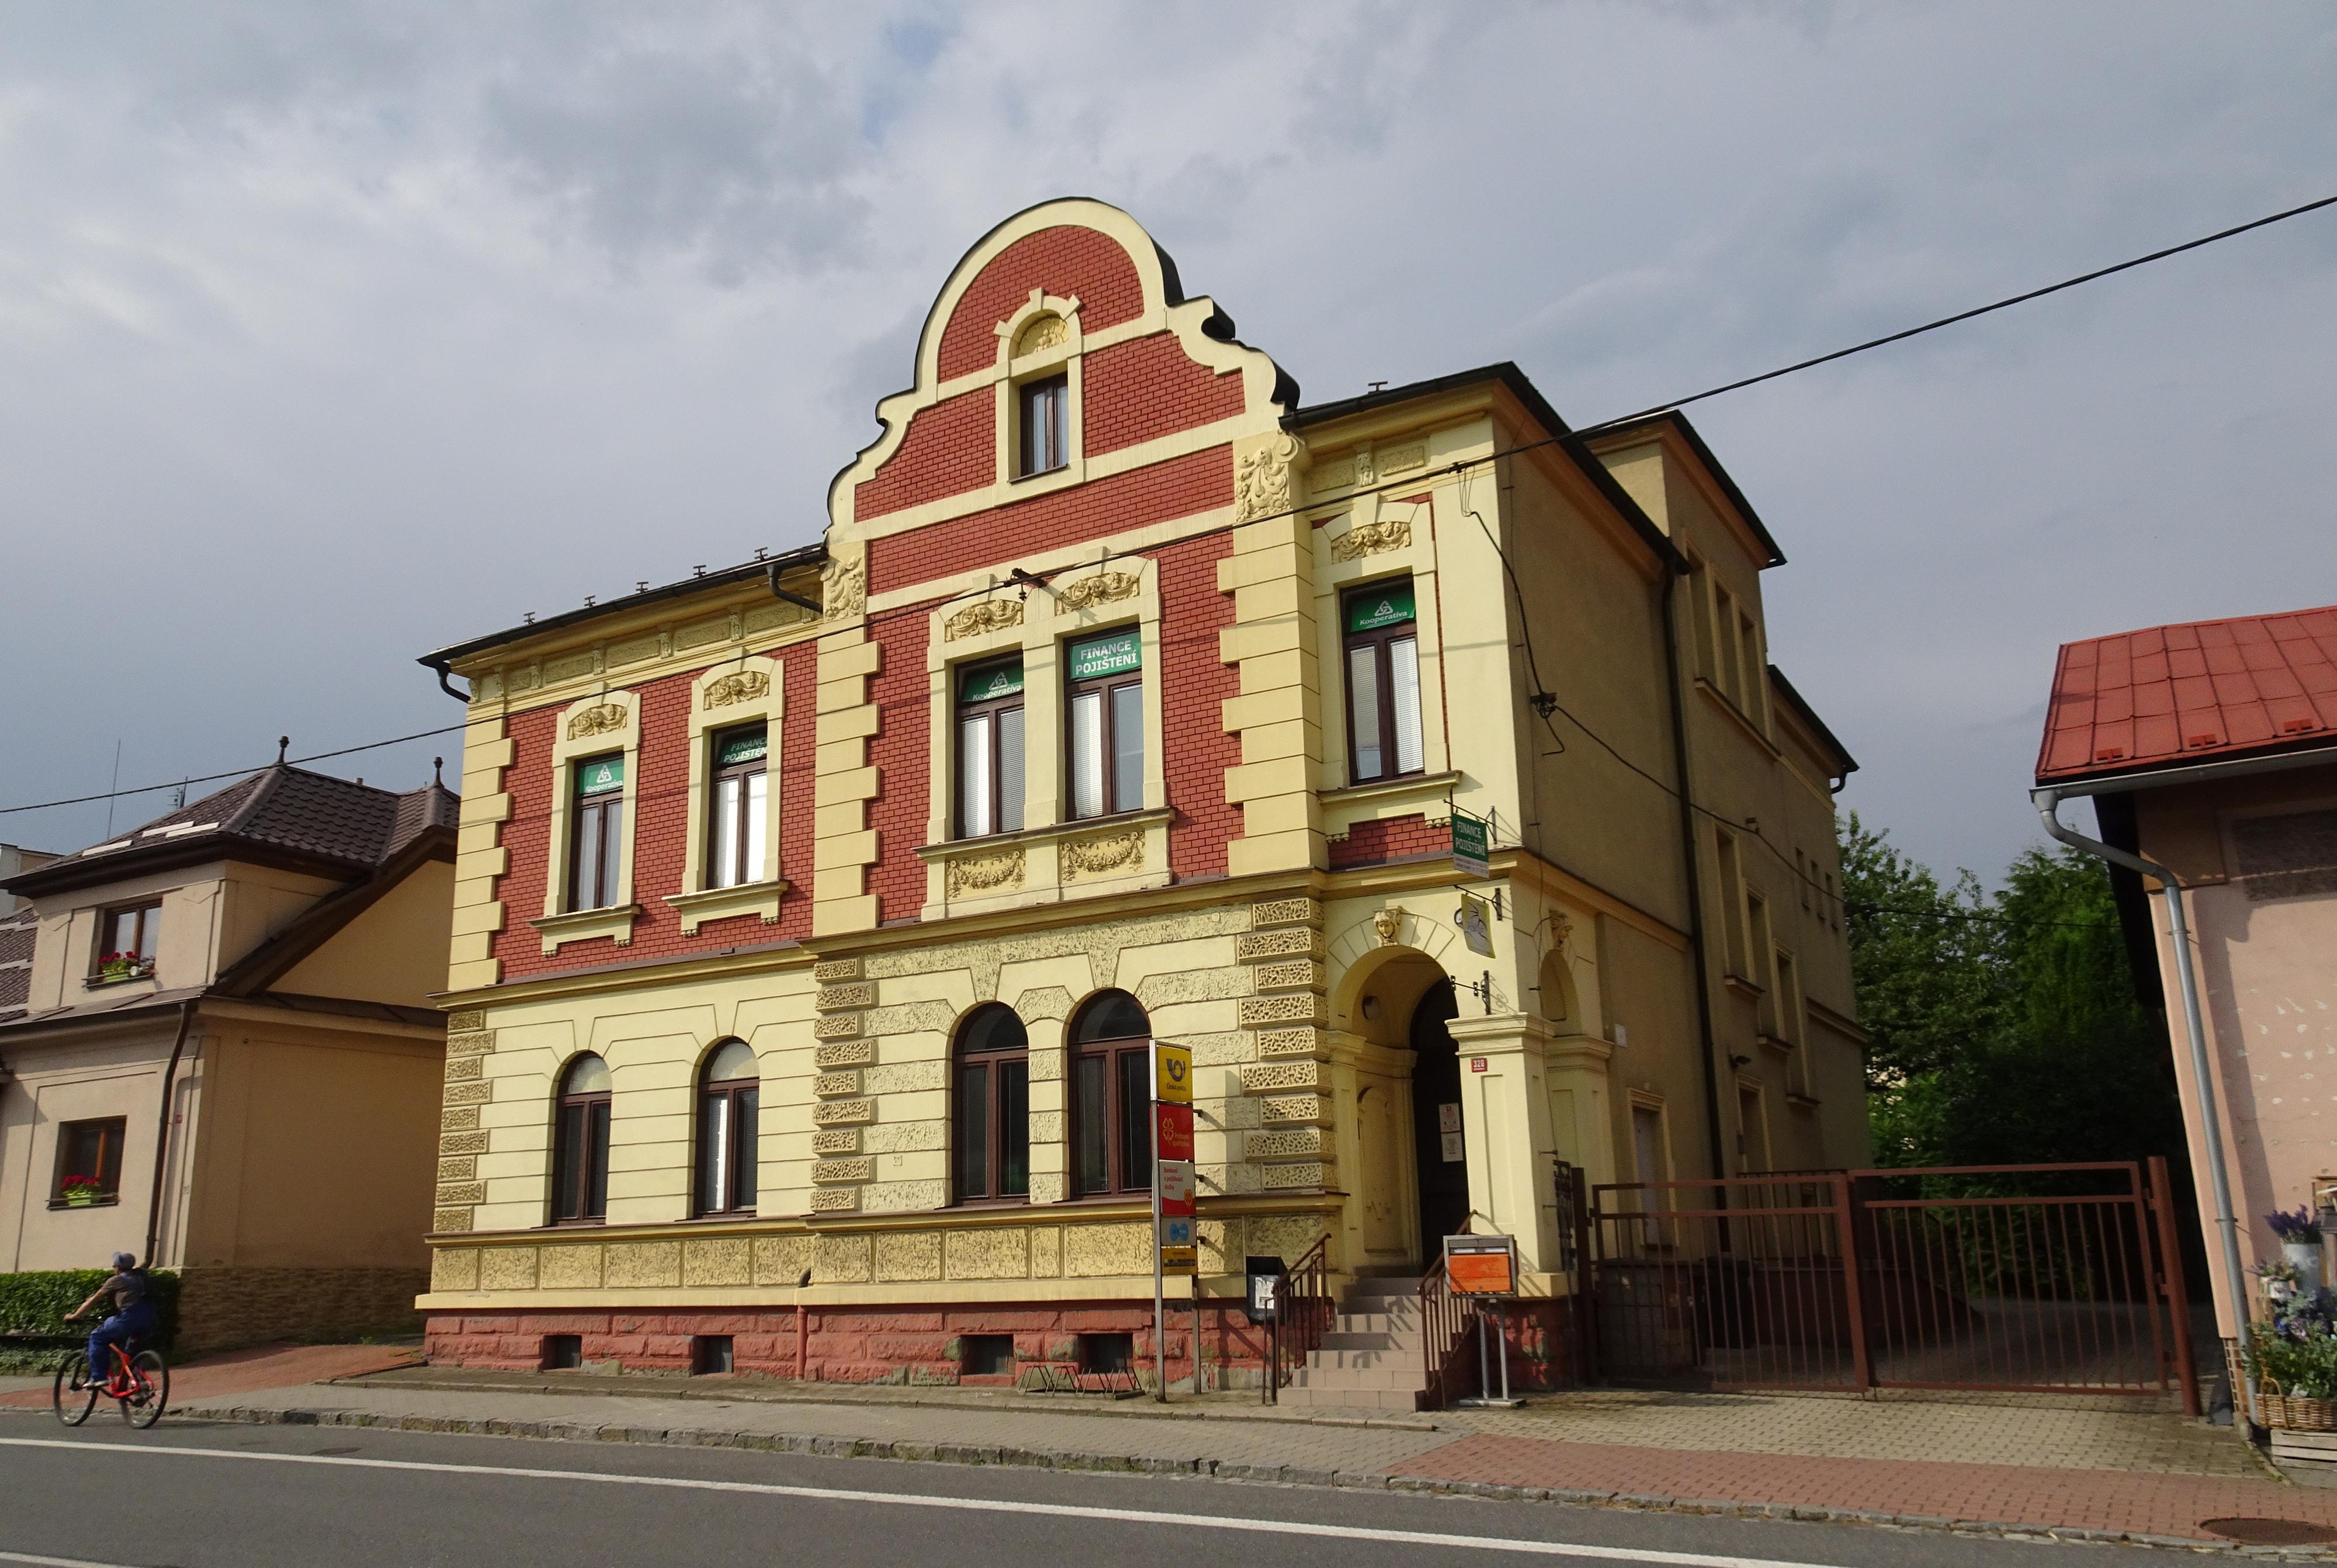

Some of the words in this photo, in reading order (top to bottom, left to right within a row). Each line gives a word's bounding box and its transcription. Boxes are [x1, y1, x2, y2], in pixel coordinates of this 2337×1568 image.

[1360, 611, 1407, 625] Kooperativa
[1080, 640, 1131, 660] FINANCE
[1076, 650, 1137, 675] POJIŠTĚNÍ
[972, 685, 1021, 700] Kooperativa
[724, 745, 767, 762] POJIŠTĚN
[585, 779, 623, 793] Kooperativa
[1457, 821, 1481, 838] FINANCE
